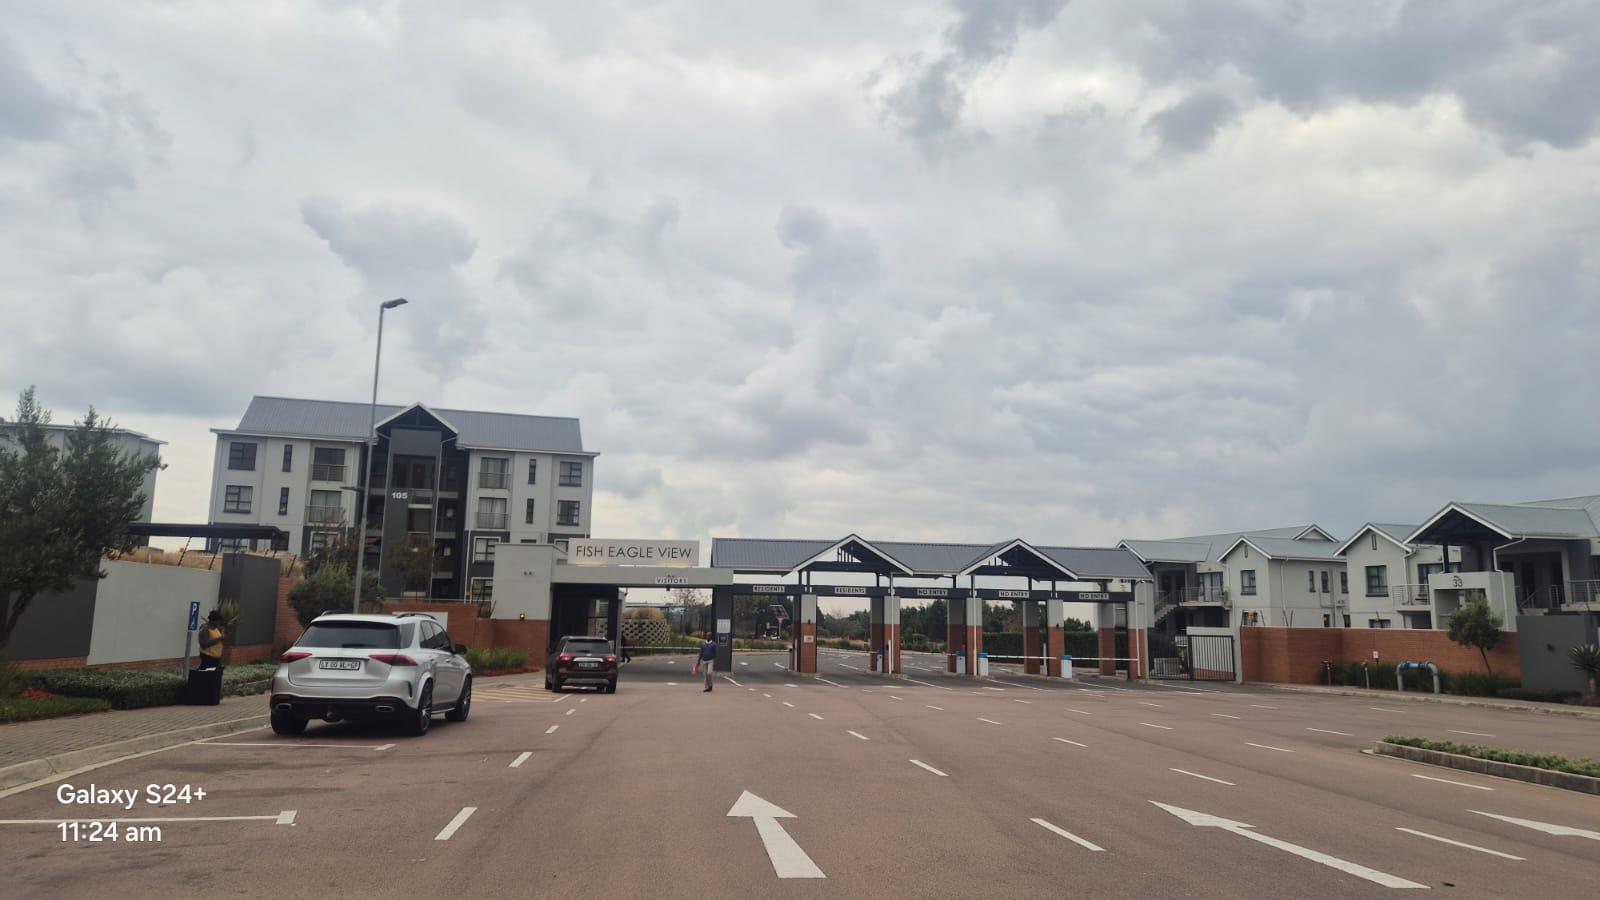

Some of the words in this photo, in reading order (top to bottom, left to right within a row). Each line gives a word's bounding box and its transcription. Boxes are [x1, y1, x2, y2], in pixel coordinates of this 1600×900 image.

[391, 491, 408, 500] 105
[576, 545, 603, 558] FISH
[608, 546, 653, 558] EAGLE
[658, 546, 692, 559] VIEW
